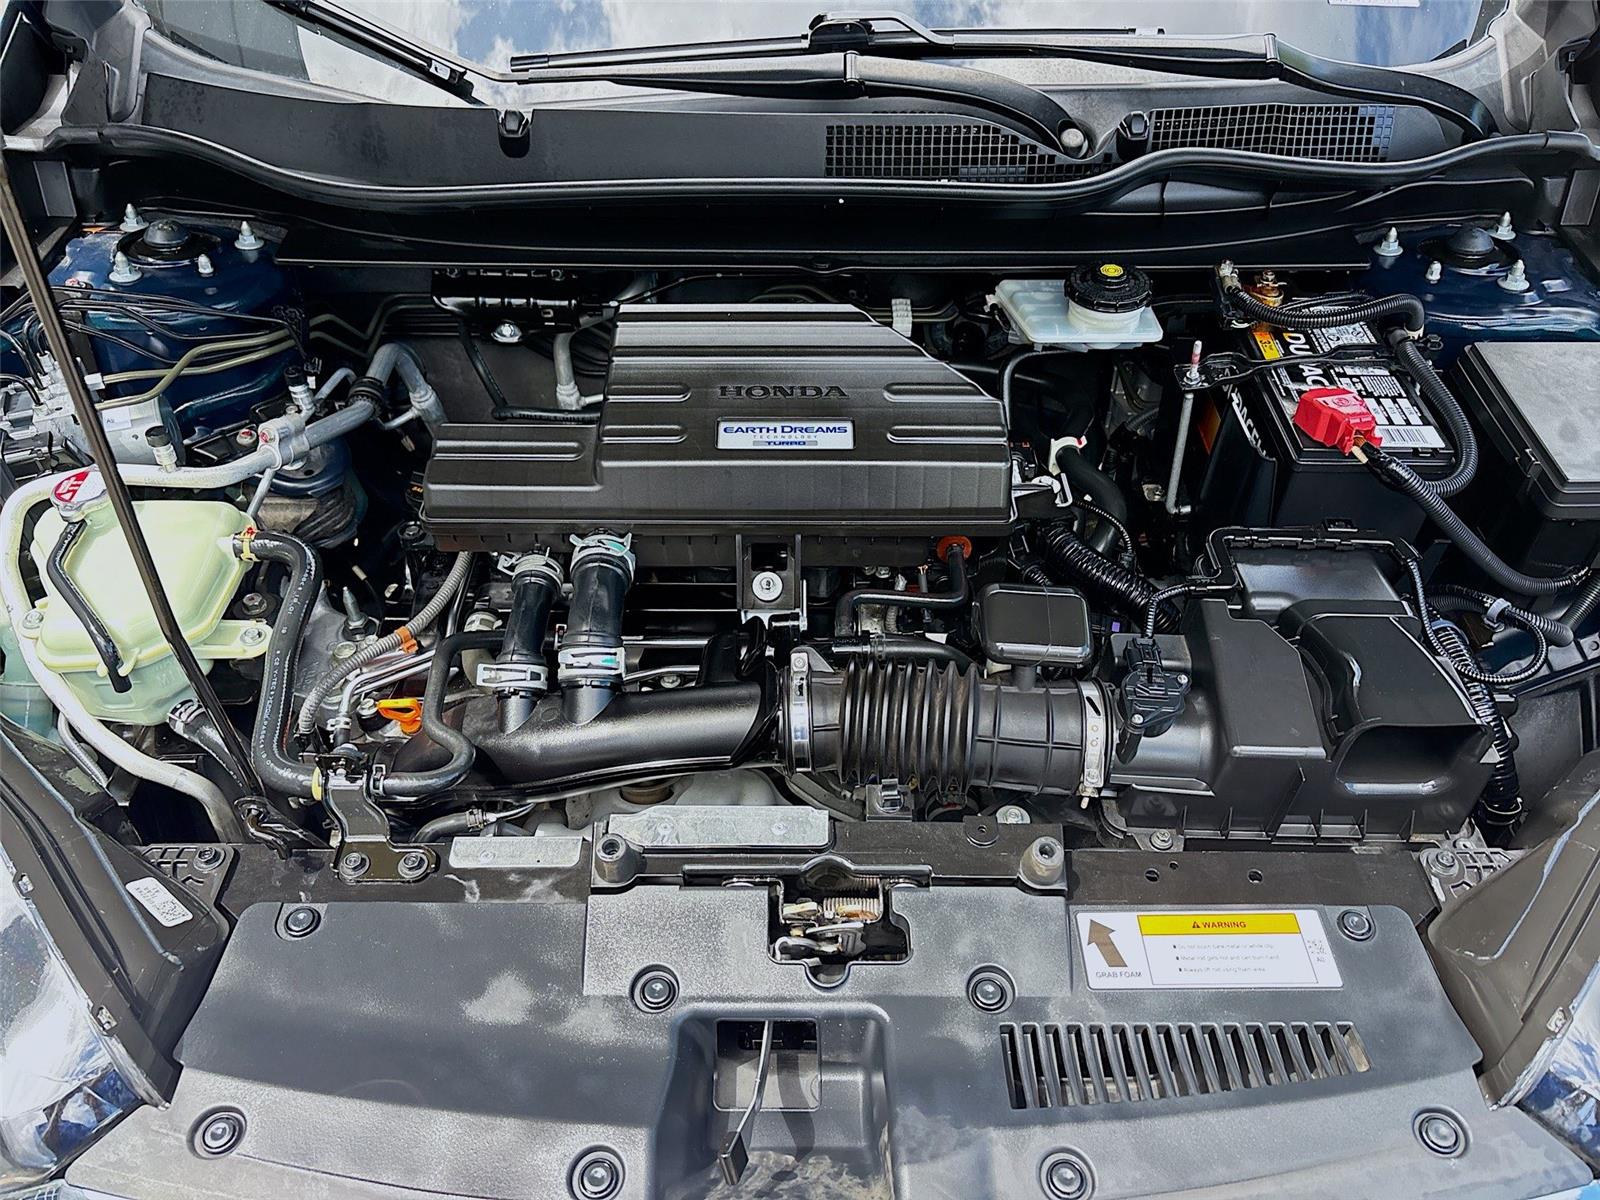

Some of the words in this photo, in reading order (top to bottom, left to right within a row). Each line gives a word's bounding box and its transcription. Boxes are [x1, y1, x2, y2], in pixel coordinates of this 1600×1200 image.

[719, 385, 849, 400] HONDA
[723, 426, 777, 434] EARTH
[780, 425, 848, 434] DREAMS
[1202, 921, 1247, 929] WARNING
